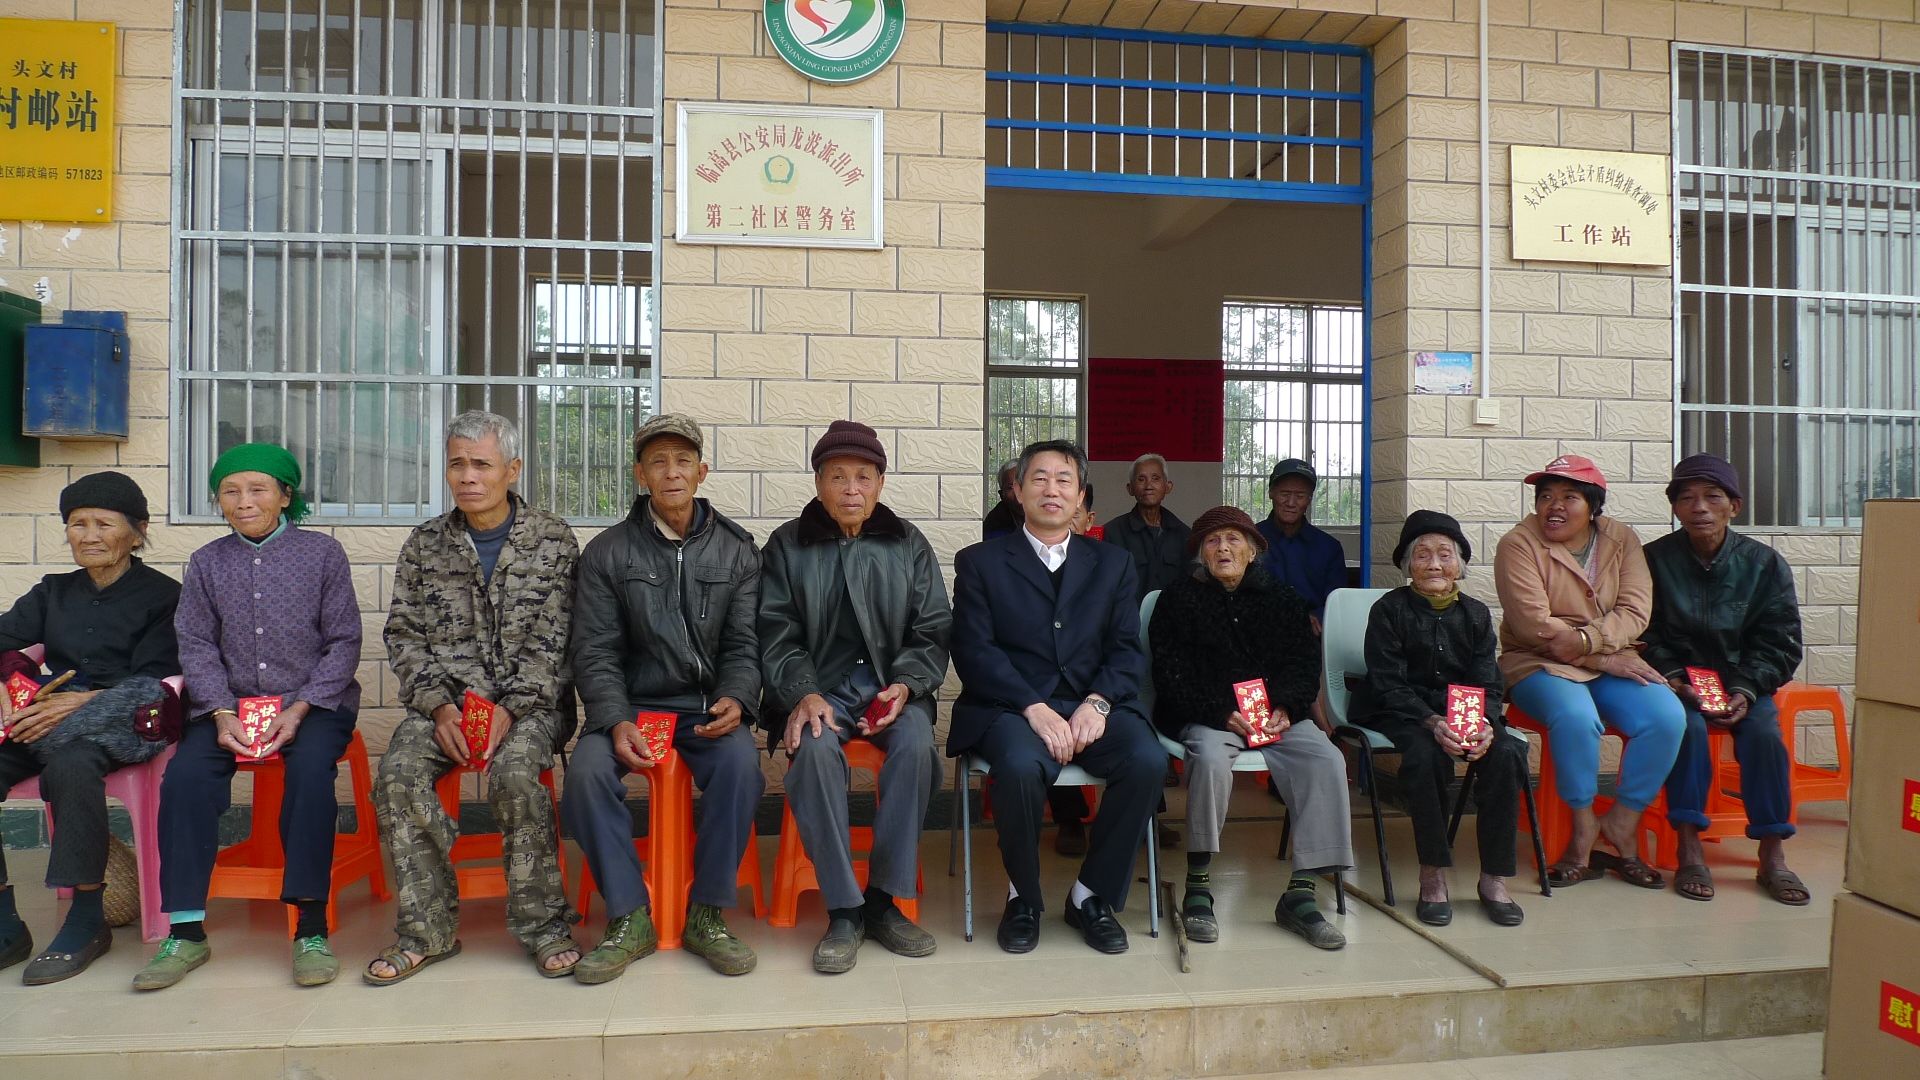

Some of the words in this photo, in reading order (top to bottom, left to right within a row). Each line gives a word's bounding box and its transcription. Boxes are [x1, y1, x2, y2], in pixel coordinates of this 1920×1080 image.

[772, 18, 802, 61] LINGAOXIAN
[801, 57, 820, 70] LING
[821, 64, 853, 73] GONGLI
[853, 56, 876, 71] FUWU
[875, 18, 897, 58] ZHONGXIN
[11, 59, 78, 80] 头文村
[695, 124, 865, 188] 临高县公安局龙波派出所
[66, 168, 103, 181] 571823
[706, 203, 856, 232] 第二社区警务室
[1553, 223, 1632, 247] 工作站
[1888, 996, 1920, 1034] 慰
